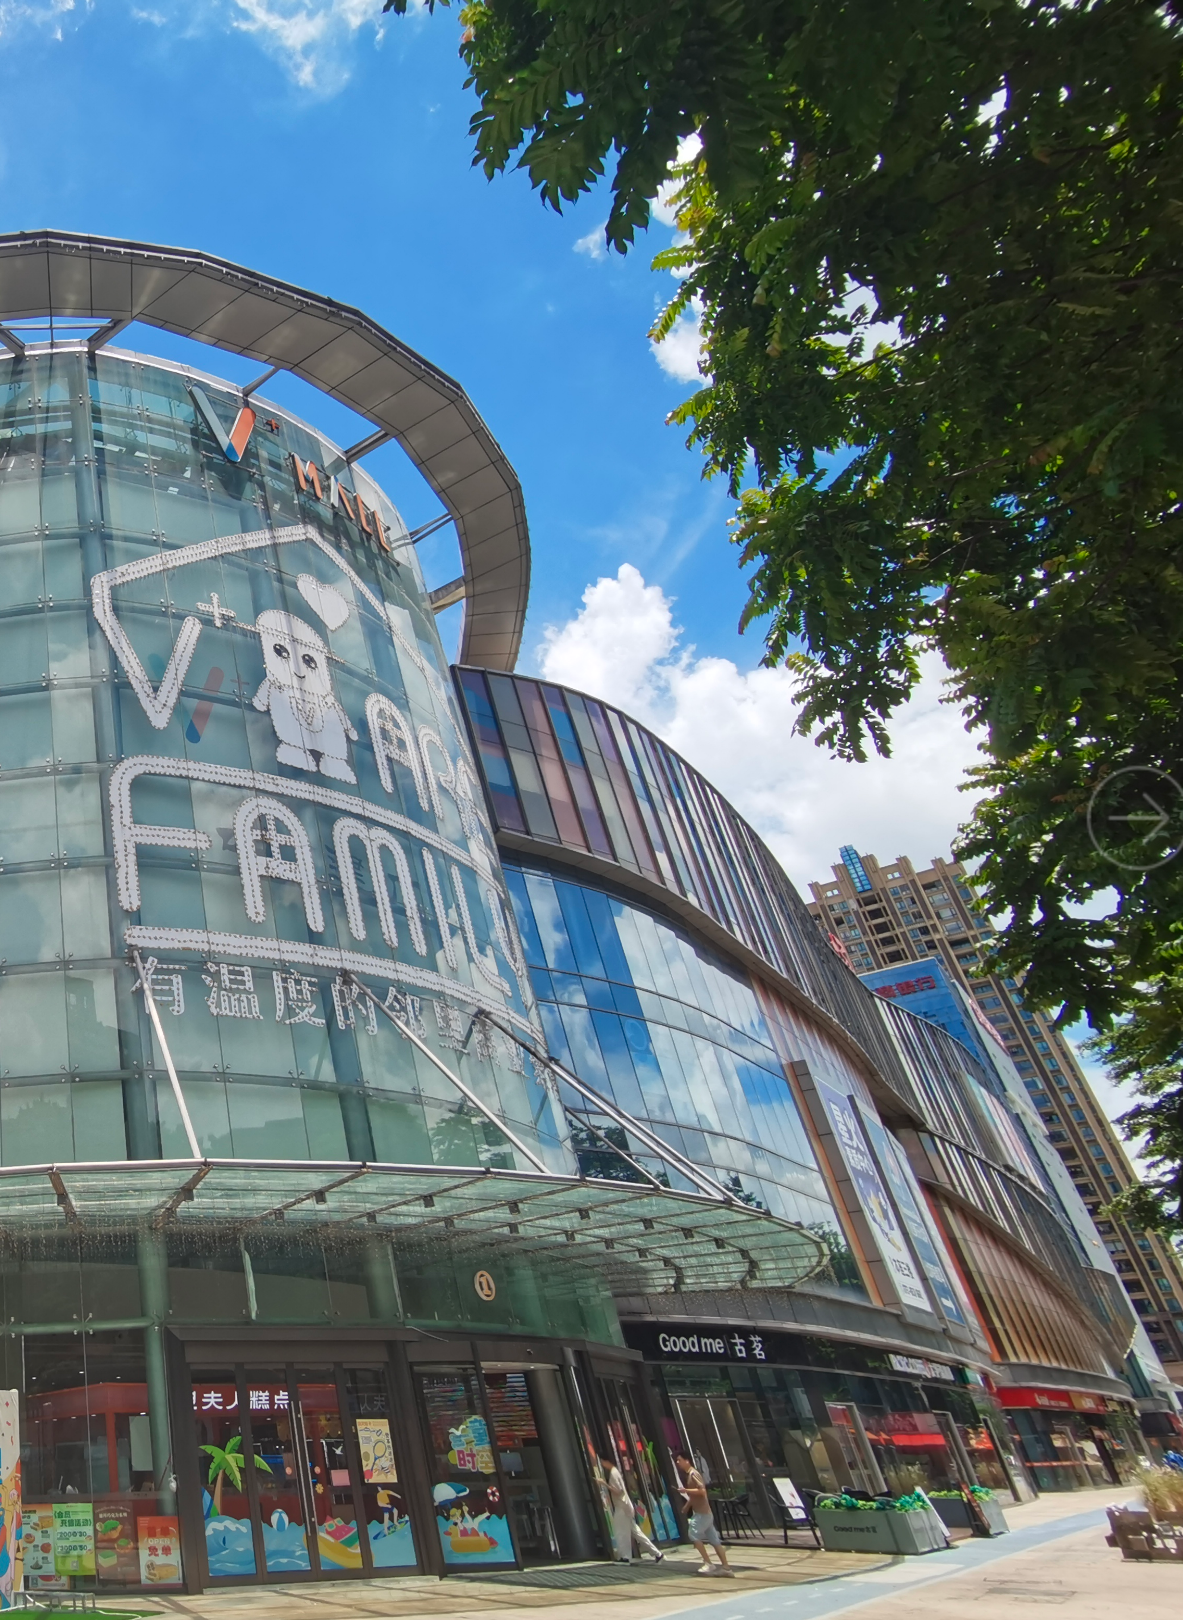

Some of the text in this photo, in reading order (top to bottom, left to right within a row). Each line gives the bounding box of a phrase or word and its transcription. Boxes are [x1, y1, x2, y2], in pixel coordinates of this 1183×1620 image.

[108, 753, 530, 1013] FAMILY
[658, 1332, 766, 1360] Good me 古茗
